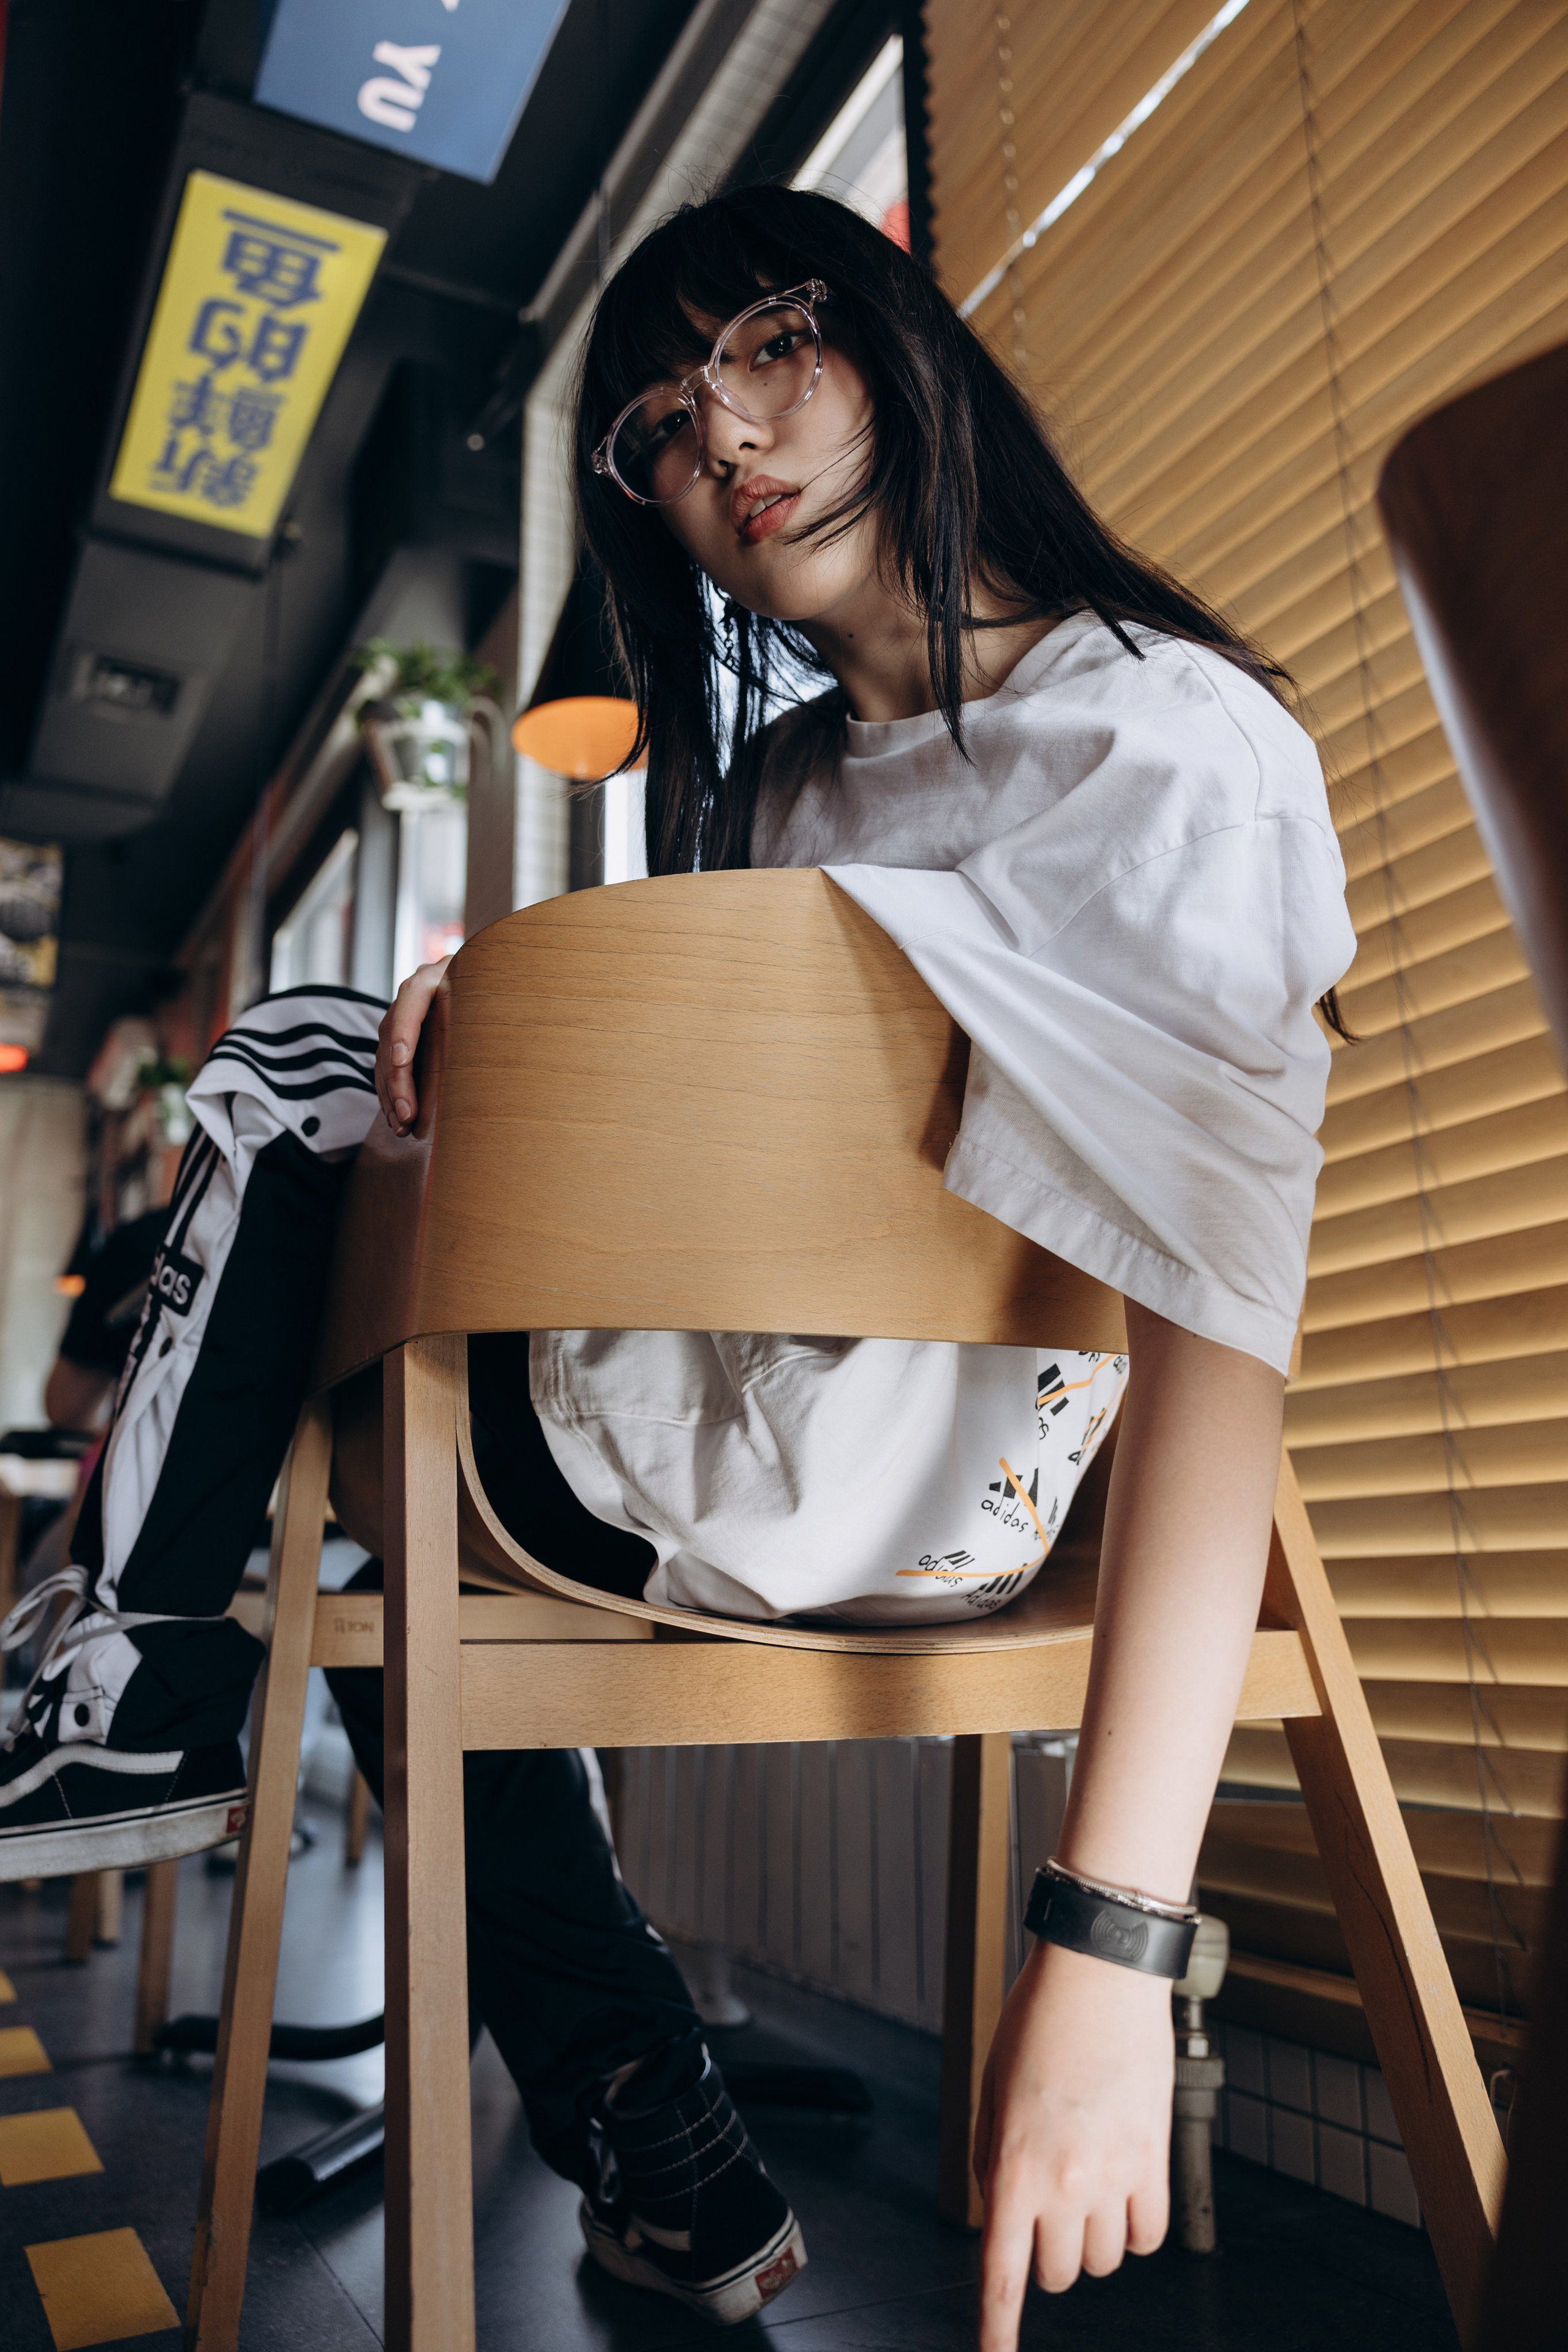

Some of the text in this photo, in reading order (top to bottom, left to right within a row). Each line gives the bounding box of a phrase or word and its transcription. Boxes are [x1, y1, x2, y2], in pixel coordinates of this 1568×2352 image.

[357, 40, 441, 133] YU
[148, 208, 342, 508] 新鲜的鱼
[981, 1496, 1028, 1532] adidas
